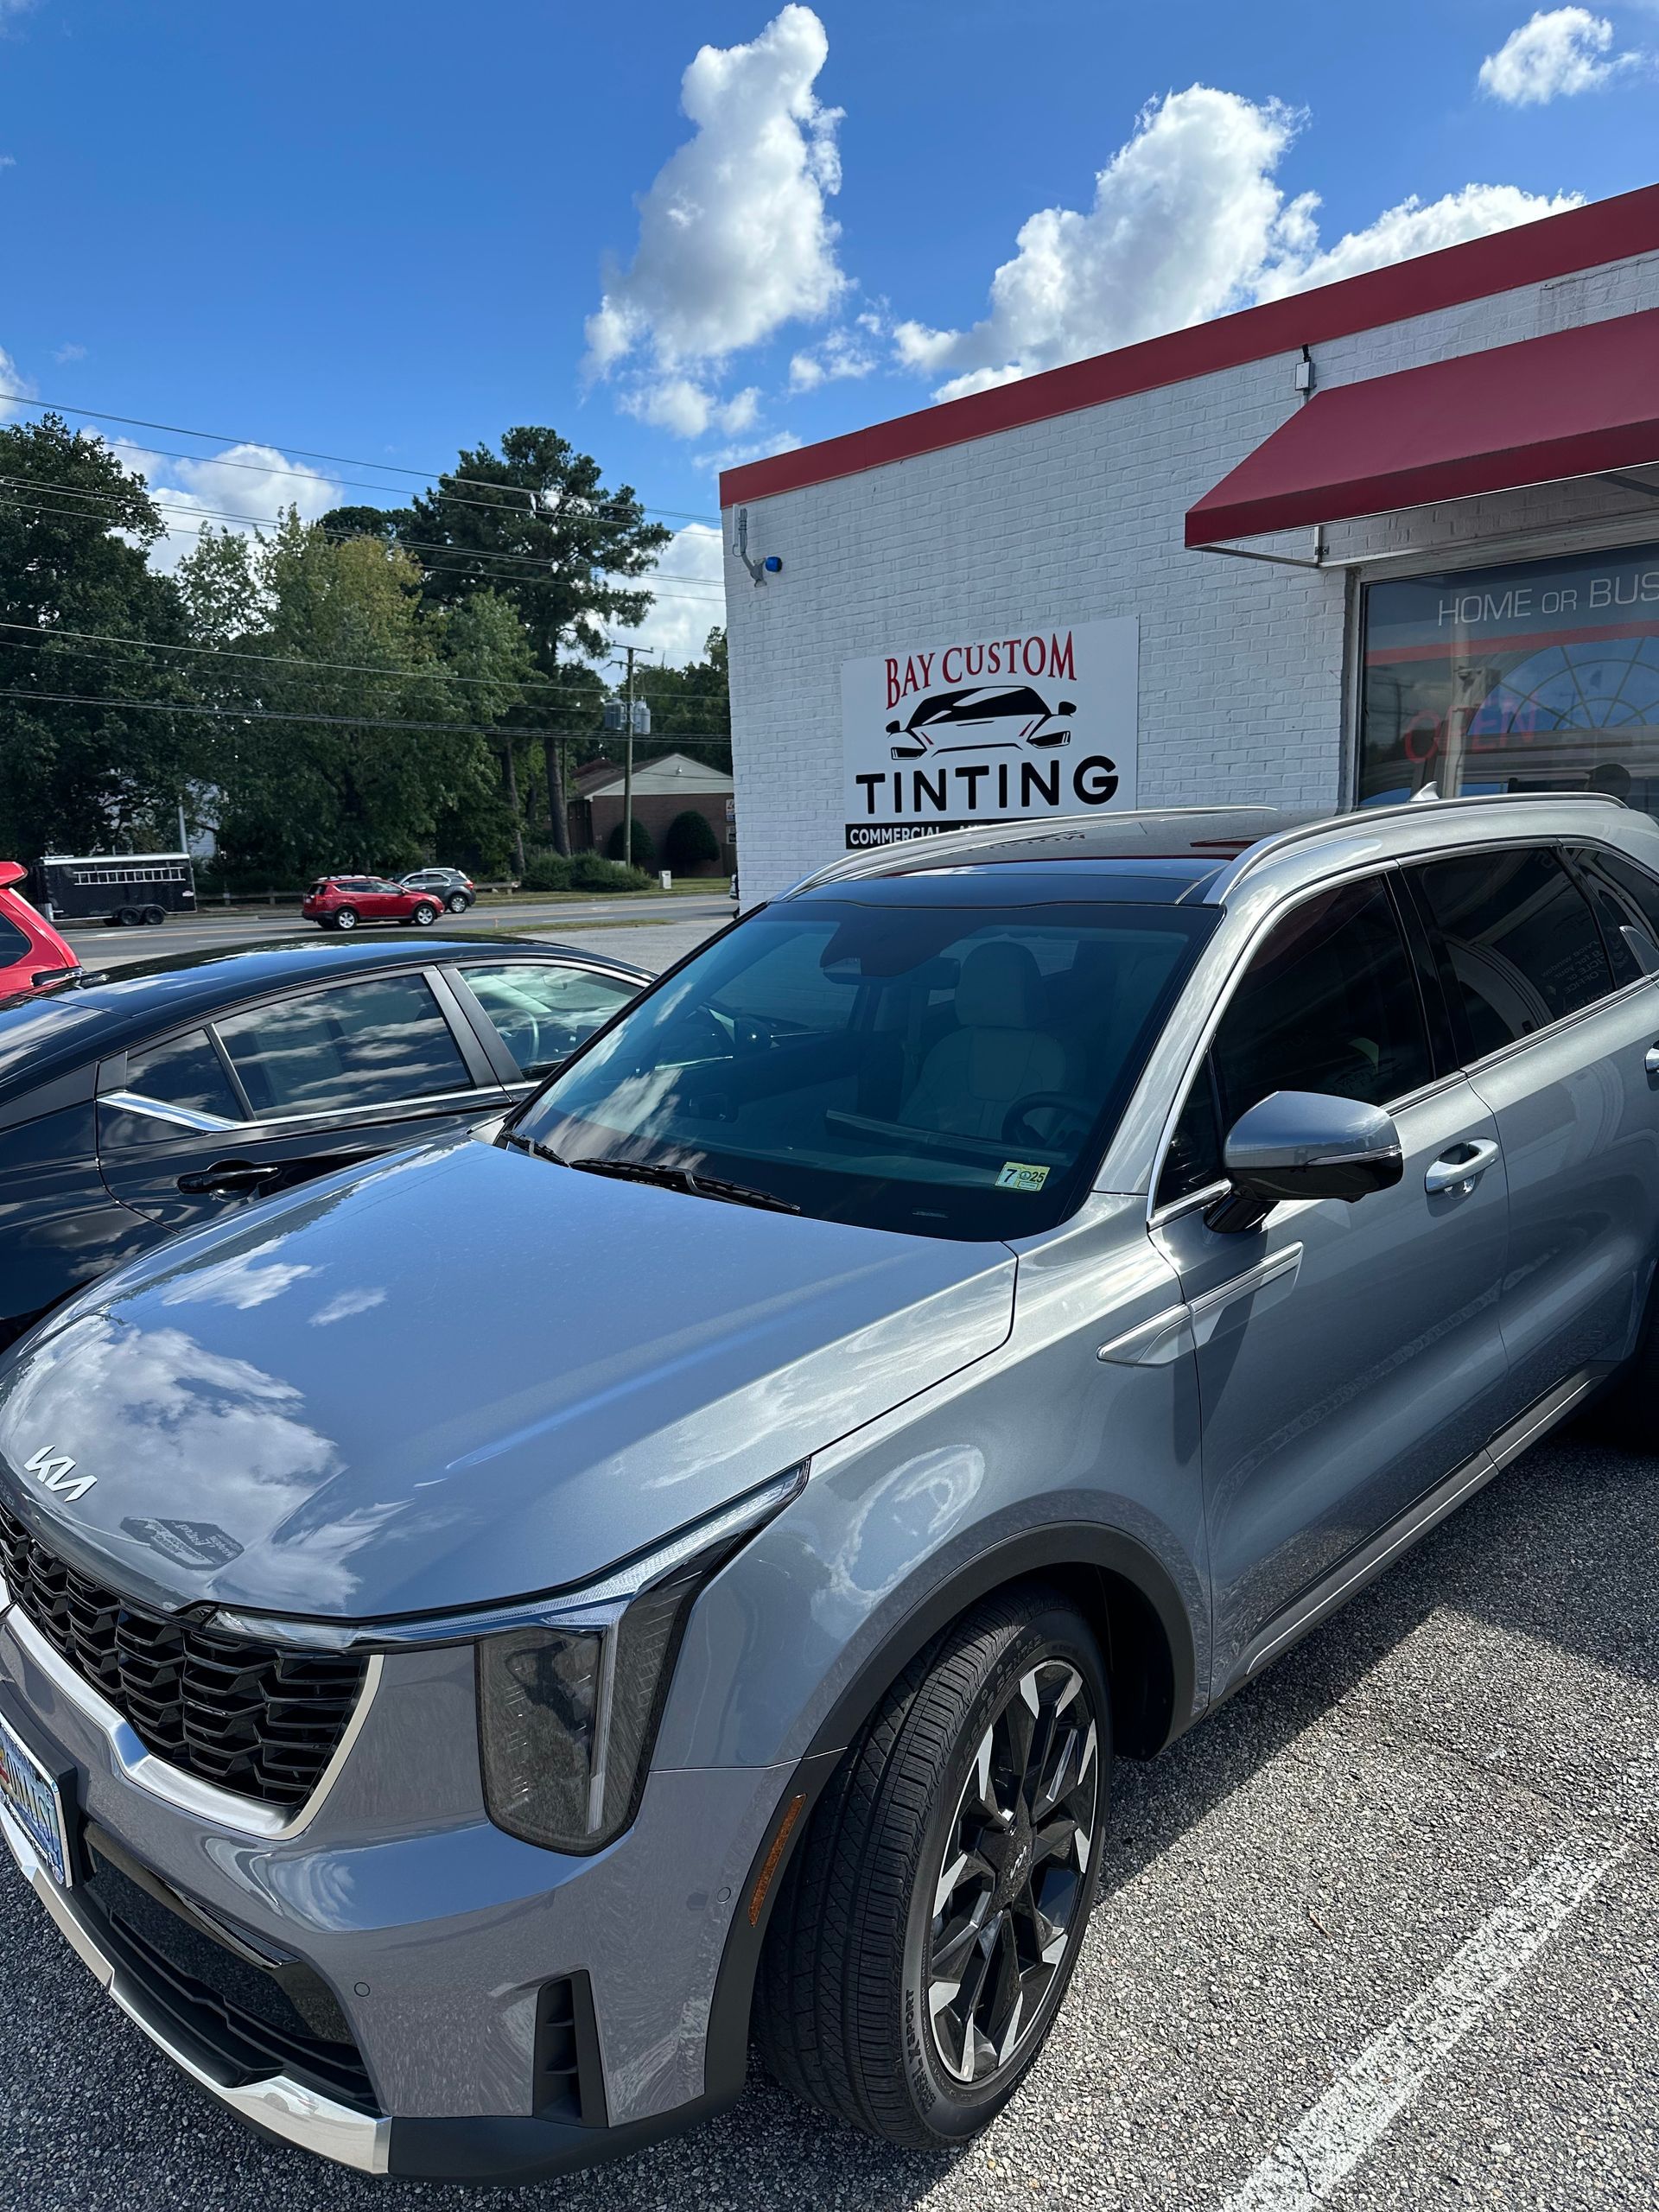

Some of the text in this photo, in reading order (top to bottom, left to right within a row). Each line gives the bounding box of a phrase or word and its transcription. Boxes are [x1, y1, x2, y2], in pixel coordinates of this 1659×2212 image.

[1438, 588, 1533, 626] HOME
[1541, 589, 1578, 614] OR
[885, 630, 1077, 710] BAY CUSTOM
[855, 755, 1119, 815] TINTING
[1004, 1168, 1046, 1183] 7 25
